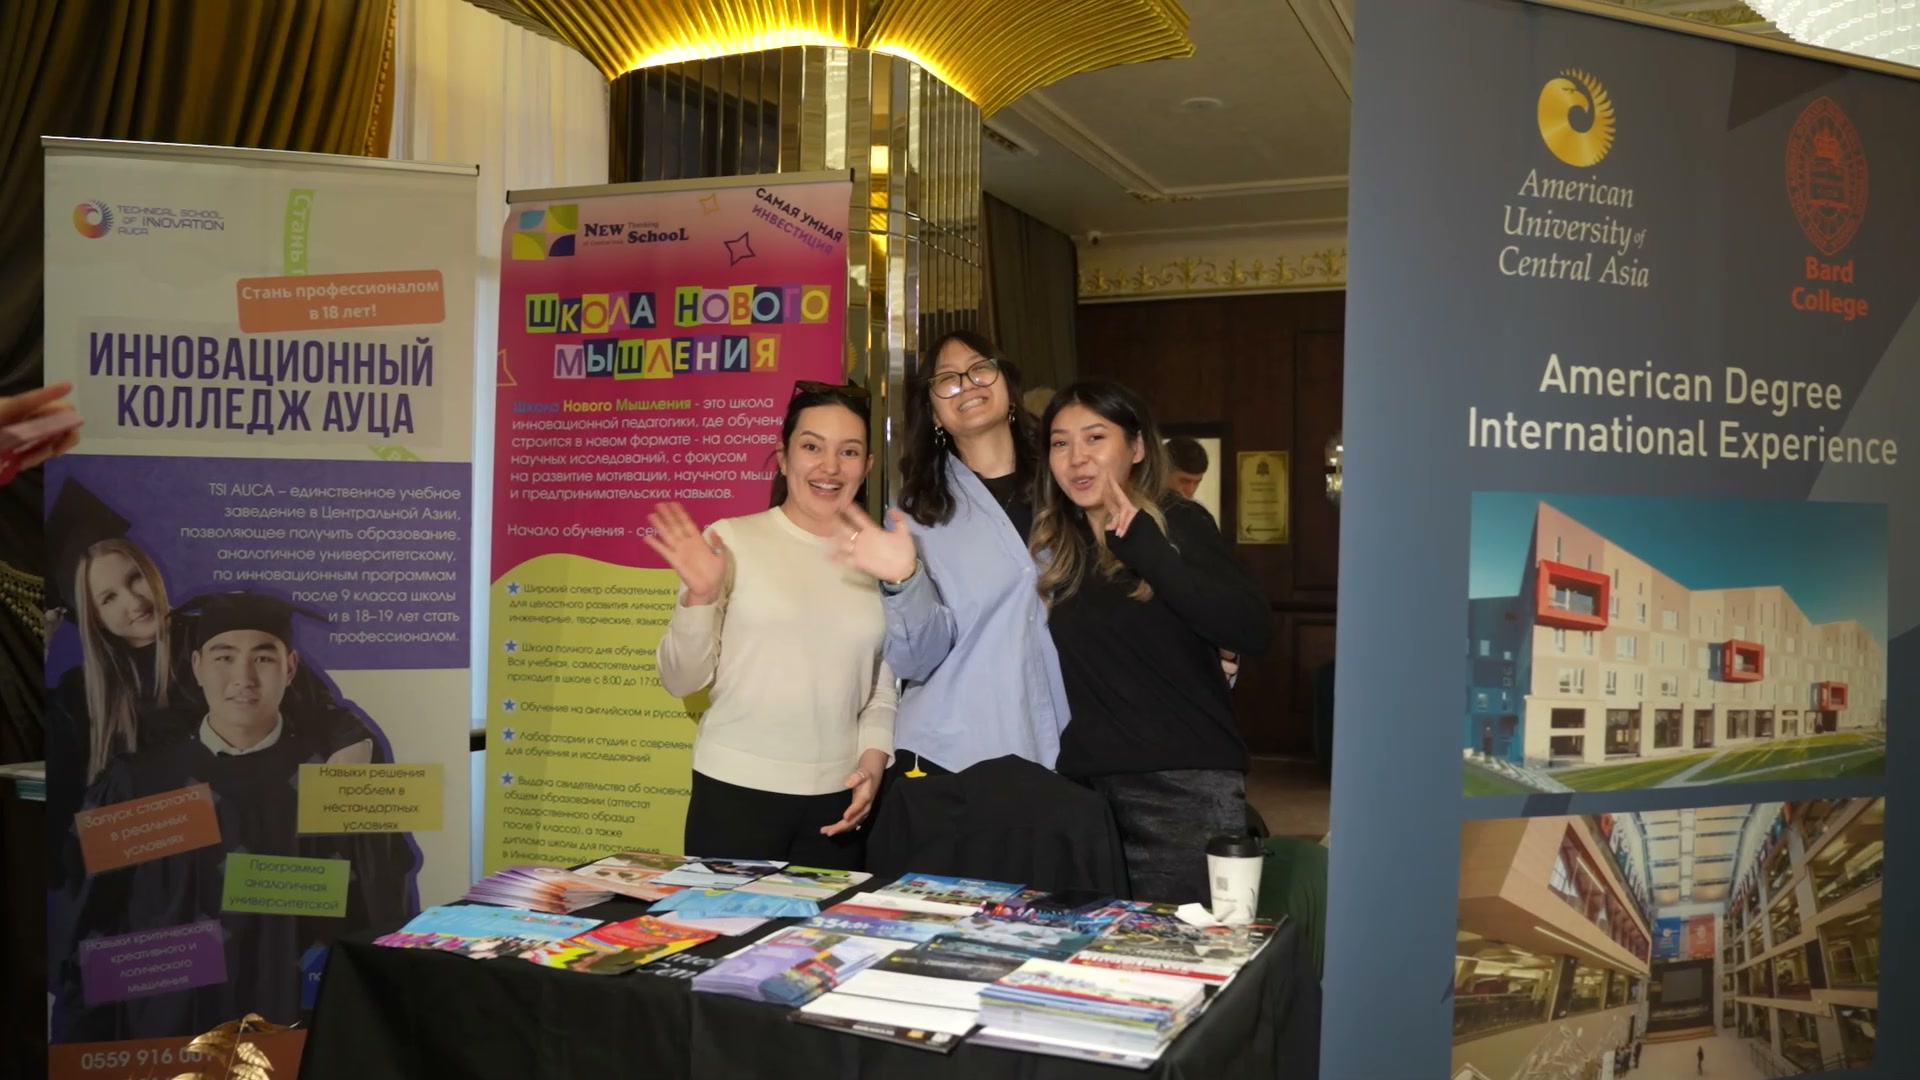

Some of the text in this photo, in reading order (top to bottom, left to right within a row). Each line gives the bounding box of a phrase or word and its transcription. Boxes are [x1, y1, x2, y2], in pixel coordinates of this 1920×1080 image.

[1518, 168, 1634, 208] American
[755, 187, 844, 243] САМАЯ УМНАЯ
[123, 217, 225, 231] OF INNOVATION
[290, 194, 311, 263] Стань
[584, 223, 625, 237] NEW
[752, 203, 833, 256] ИНВЕСТИЦИЯ
[1503, 205, 1647, 255] University of
[1499, 245, 1649, 288] Central Asia
[1805, 256, 1854, 283] Bard
[242, 279, 439, 301] Стань профессионалом
[309, 304, 377, 320] в 18 лет!
[528, 287, 829, 333] ШКОЛА НОВОГО
[1791, 287, 1869, 320] College
[89, 331, 433, 386] ИННОВАЦИОННЫЙ
[556, 338, 776, 377] МЫШЛЕНИЯ
[1539, 353, 1842, 417] American Degree
[117, 384, 414, 438] КОЛЛЕДЖ АУЦА
[513, 397, 773, 413] Школа Нового Мышления это школа
[512, 416, 724, 431] инновационной педагогики, где
[512, 432, 777, 449] строится в новом формате на основе
[1469, 406, 1898, 468] International Experience
[511, 449, 747, 467] научных исследований, с фокусом
[510, 469, 737, 484] на развитие мотивации, научного
[209, 482, 461, 502] TSI AUCA единственное учебное
[510, 487, 734, 502] и предпринимательских навыков.
[224, 505, 461, 522] заведение в Центральной Азии,
[180, 527, 461, 543] позволяющее получить образование,
[507, 524, 559, 536] Начало
[563, 524, 624, 538] обучения
[217, 549, 456, 563] аналогичное университетскому,
[213, 569, 456, 584] по инновационным программам
[292, 589, 456, 603] после 9 класса школы
[523, 584, 670, 596] Широкий спектр обязательных
[509, 600, 528, 609] для
[529, 600, 584, 610] целостного
[586, 601, 628, 611] развития
[328, 611, 338, 622] и
[342, 611, 350, 622] в
[396, 611, 419, 623] лет
[423, 612, 460, 623] стать
[509, 616, 634, 626] инженерные, творческие,
[329, 630, 459, 644] профессионалом.
[522, 643, 613, 655] Школа полного дня
[508, 658, 656, 671] Вся учебная, самостоятельная
[507, 673, 553, 683] проходит
[562, 674, 591, 684] школе
[602, 675, 621, 685] 8:00
[623, 678, 636, 686] до
[520, 701, 568, 714] Обучение
[571, 705, 583, 714] на
[585, 706, 642, 718] английском
[652, 709, 697, 719] русском
[520, 732, 628, 747] Лаборатории студии
[505, 747, 651, 763] для обучения исследований
[319, 767, 425, 779] Навыки решения
[339, 784, 395, 797] проблем
[518, 776, 553, 787] Выдача
[555, 779, 625, 793] свидетельства
[628, 783, 641, 793] об
[504, 790, 651, 809] общем образовании (аттестат
[84, 791, 200, 828] Запуск стартапа
[324, 804, 418, 815] нестандартных
[504, 806, 635, 824] государственного образца
[121, 814, 189, 841] реальных
[343, 821, 398, 832] условиях
[503, 821, 533, 831] после
[594, 828, 623, 838] также
[123, 834, 185, 859] условиях
[502, 836, 597, 851] диплома школы для
[510, 851, 587, 864] Инновационный
[250, 859, 325, 875] Программа
[245, 878, 327, 892] аналогичная
[229, 896, 339, 911] университетской
[85, 923, 214, 950] Навыки критического
[111, 944, 187, 964] креативного
[120, 959, 192, 977] логического
[128, 976, 189, 993] мышления
[81, 1047, 171, 1070] 0559 916
